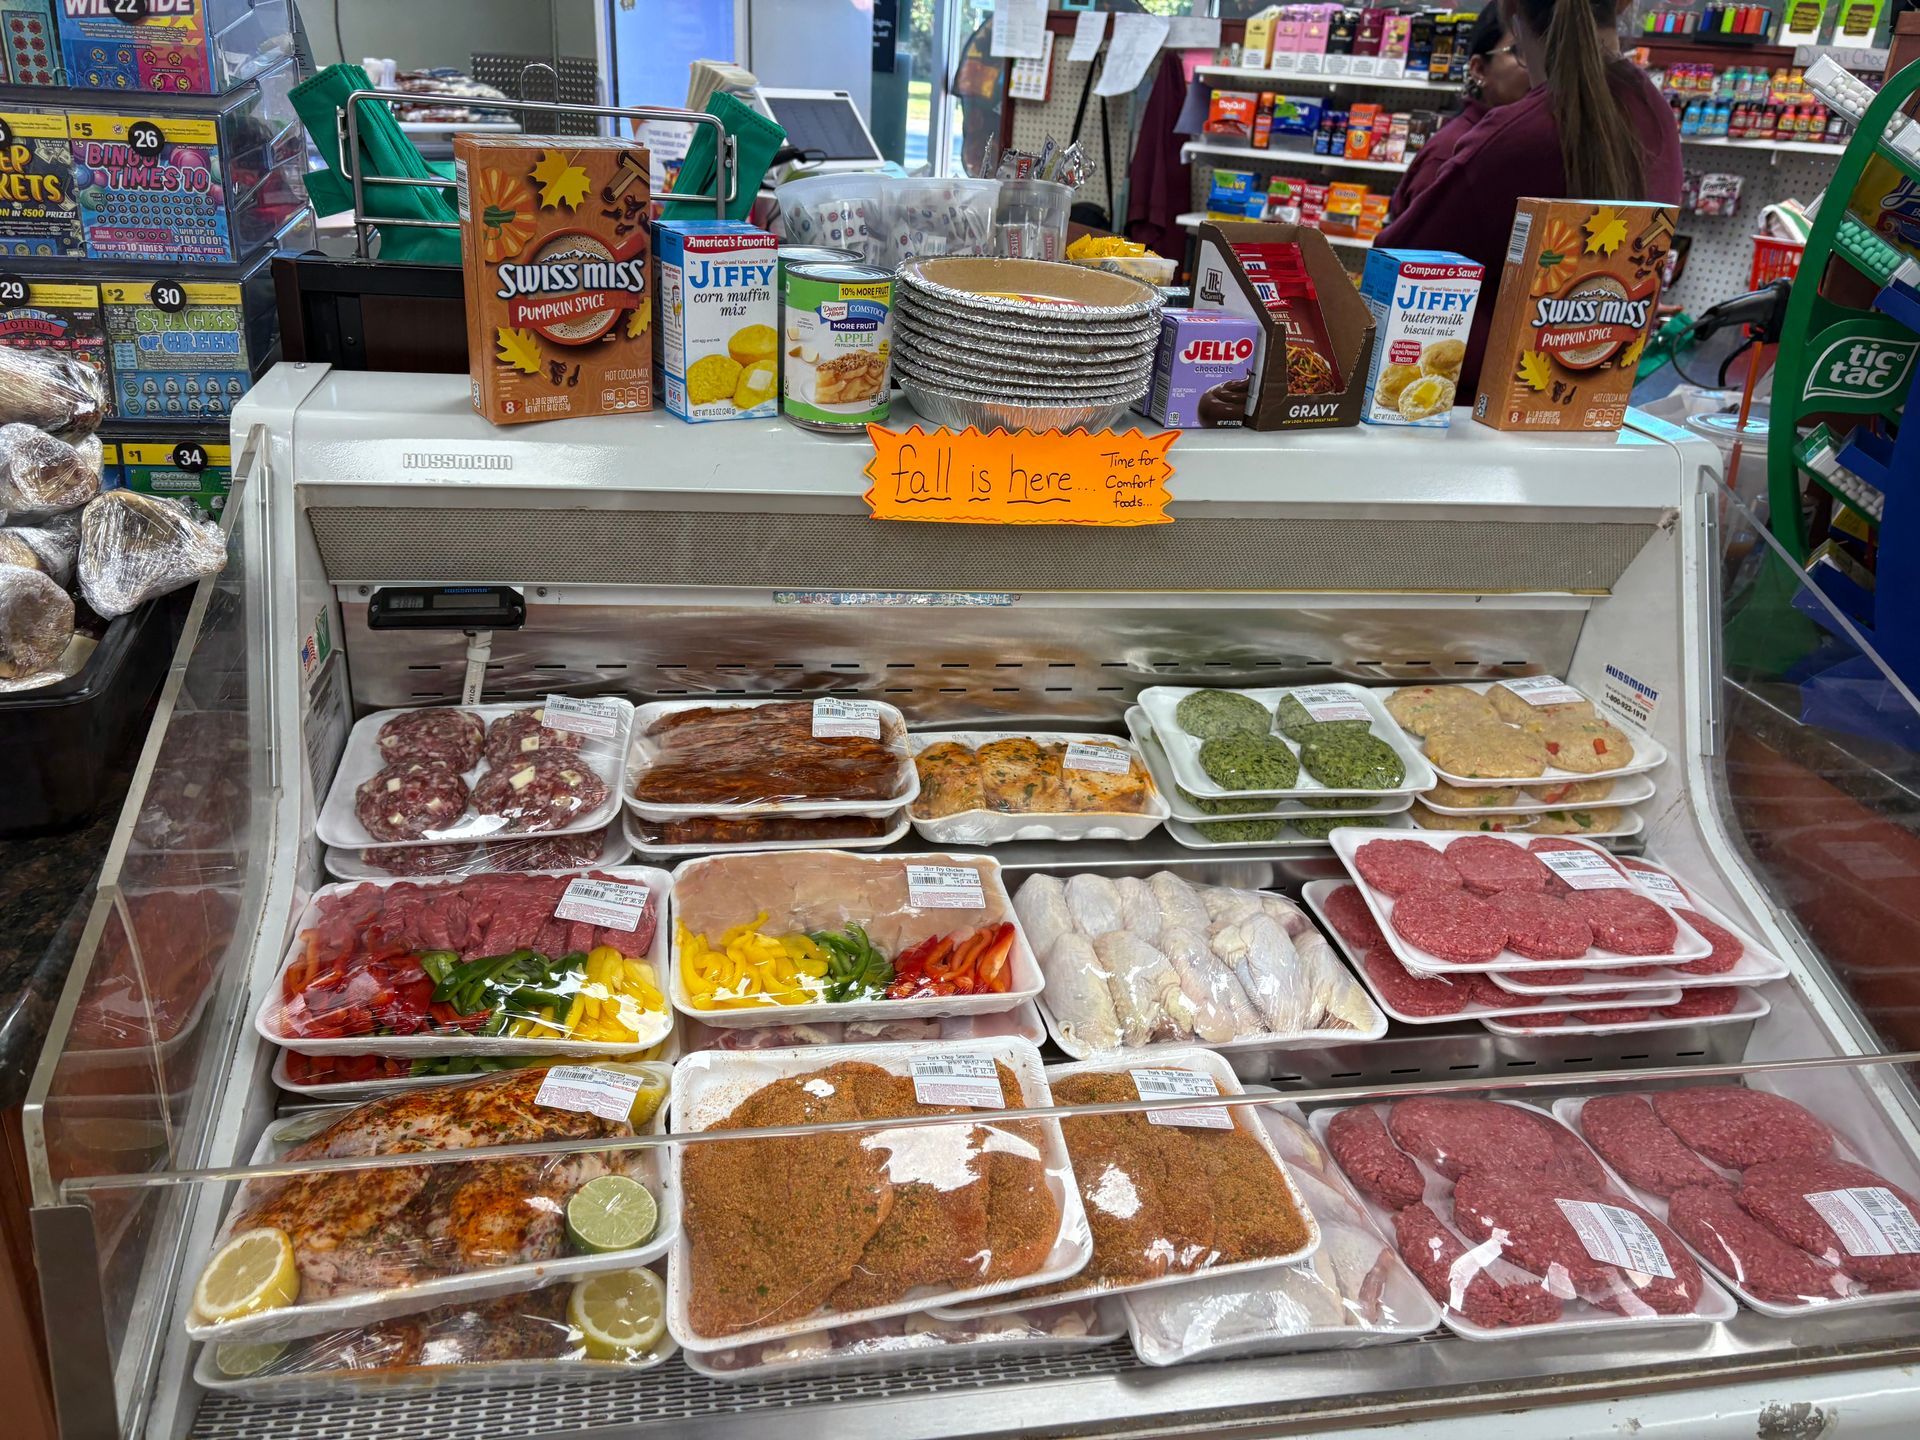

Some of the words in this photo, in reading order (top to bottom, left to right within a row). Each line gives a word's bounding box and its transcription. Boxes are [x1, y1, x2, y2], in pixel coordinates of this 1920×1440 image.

[115, 0, 138, 13] 22
[74, 123, 92, 136] $5
[134, 130, 158, 148] 26
[109, 167, 179, 190] TIMES
[183, 168, 208, 191] 10
[22, 209, 45, 217] $500
[46, 211, 75, 219] PRIZES!
[127, 243, 136, 252] 10
[138, 244, 163, 253] TIMES
[687, 236, 735, 248] America's
[737, 235, 775, 247] Favorite
[497, 263, 579, 298] SWISS
[583, 259, 645, 293] MISS
[1403, 264, 1445, 277] Compare
[1447, 268, 1455, 276] &
[1457, 268, 1482, 278] Save!
[0, 282, 25, 299] 29
[107, 289, 125, 302] $2
[157, 288, 181, 305] 30
[694, 293, 724, 303] corn
[727, 288, 771, 303] muffin
[842, 287, 856, 297] 10%
[856, 287, 875, 296] MORE
[875, 286, 890, 295] FRUIT
[518, 300, 573, 323] PUMPKIN
[575, 293, 606, 313] SPICE
[720, 304, 747, 316] mix
[823, 304, 846, 313] Duncan
[849, 304, 884, 319] COMSTOCK
[1532, 298, 1597, 327] SWISS
[1599, 299, 1650, 328] MISS
[136, 309, 238, 332] STACKS
[1401, 310, 1464, 326] buttermilk
[833, 322, 855, 330] MORE
[856, 322, 876, 330] FRUIT
[1403, 326, 1435, 336] biscuit
[1435, 327, 1456, 337] mix
[162, 331, 240, 354] GREEN
[835, 332, 874, 343] APPLE
[1541, 330, 1585, 348] PUMPKIN
[1586, 327, 1613, 344] SPICE
[1849, 343, 1898, 370] tic
[603, 371, 616, 381] HOT
[617, 368, 637, 380] COCOA
[638, 367, 650, 379] MIX
[1194, 366, 1234, 374] chocolate
[1829, 361, 1889, 388] tac
[505, 401, 515, 414] 8
[1289, 403, 1340, 418] GRAVY
[1511, 412, 1519, 423] 8
[128, 450, 142, 462] $1
[179, 449, 202, 466] 34
[402, 453, 513, 470] HUSSMANN
[1101, 451, 1135, 468] Time
[1138, 449, 1160, 466] for
[891, 444, 951, 496] fall
[970, 464, 991, 494] is
[1105, 474, 1156, 490] Comfort
[1605, 664, 1659, 701] HUSSMANN
